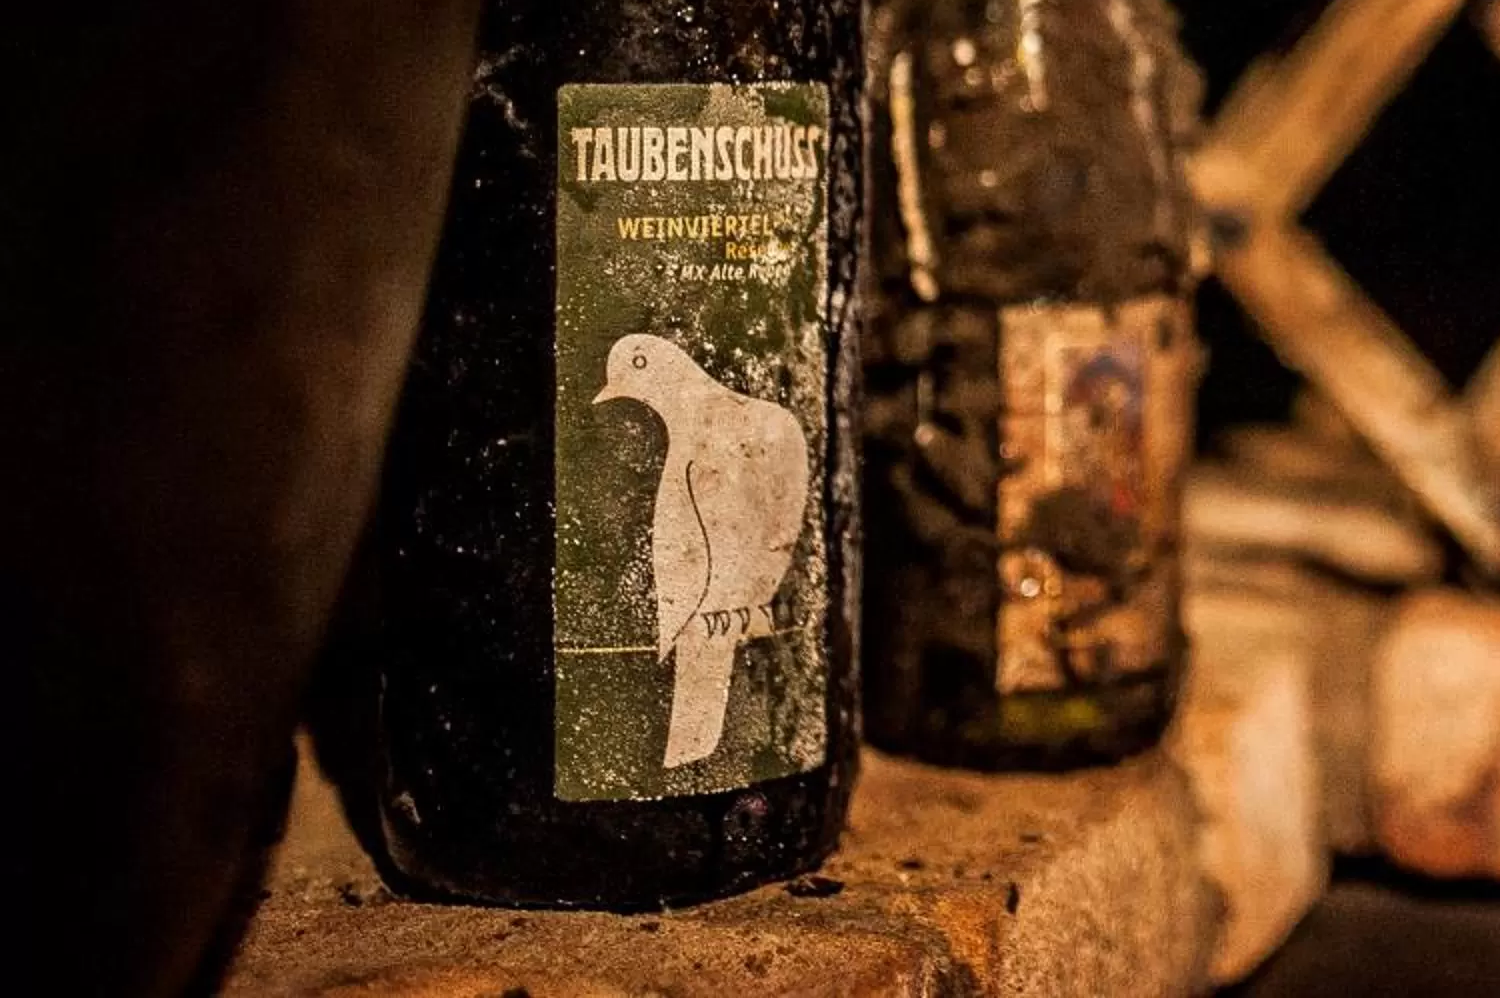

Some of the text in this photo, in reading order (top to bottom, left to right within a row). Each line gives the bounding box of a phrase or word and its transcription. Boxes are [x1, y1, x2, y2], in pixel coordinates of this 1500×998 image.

[571, 125, 821, 182] TAUBENSCHUSS
[616, 213, 773, 240] WEINVIERTEL
[708, 261, 745, 282] Alte
